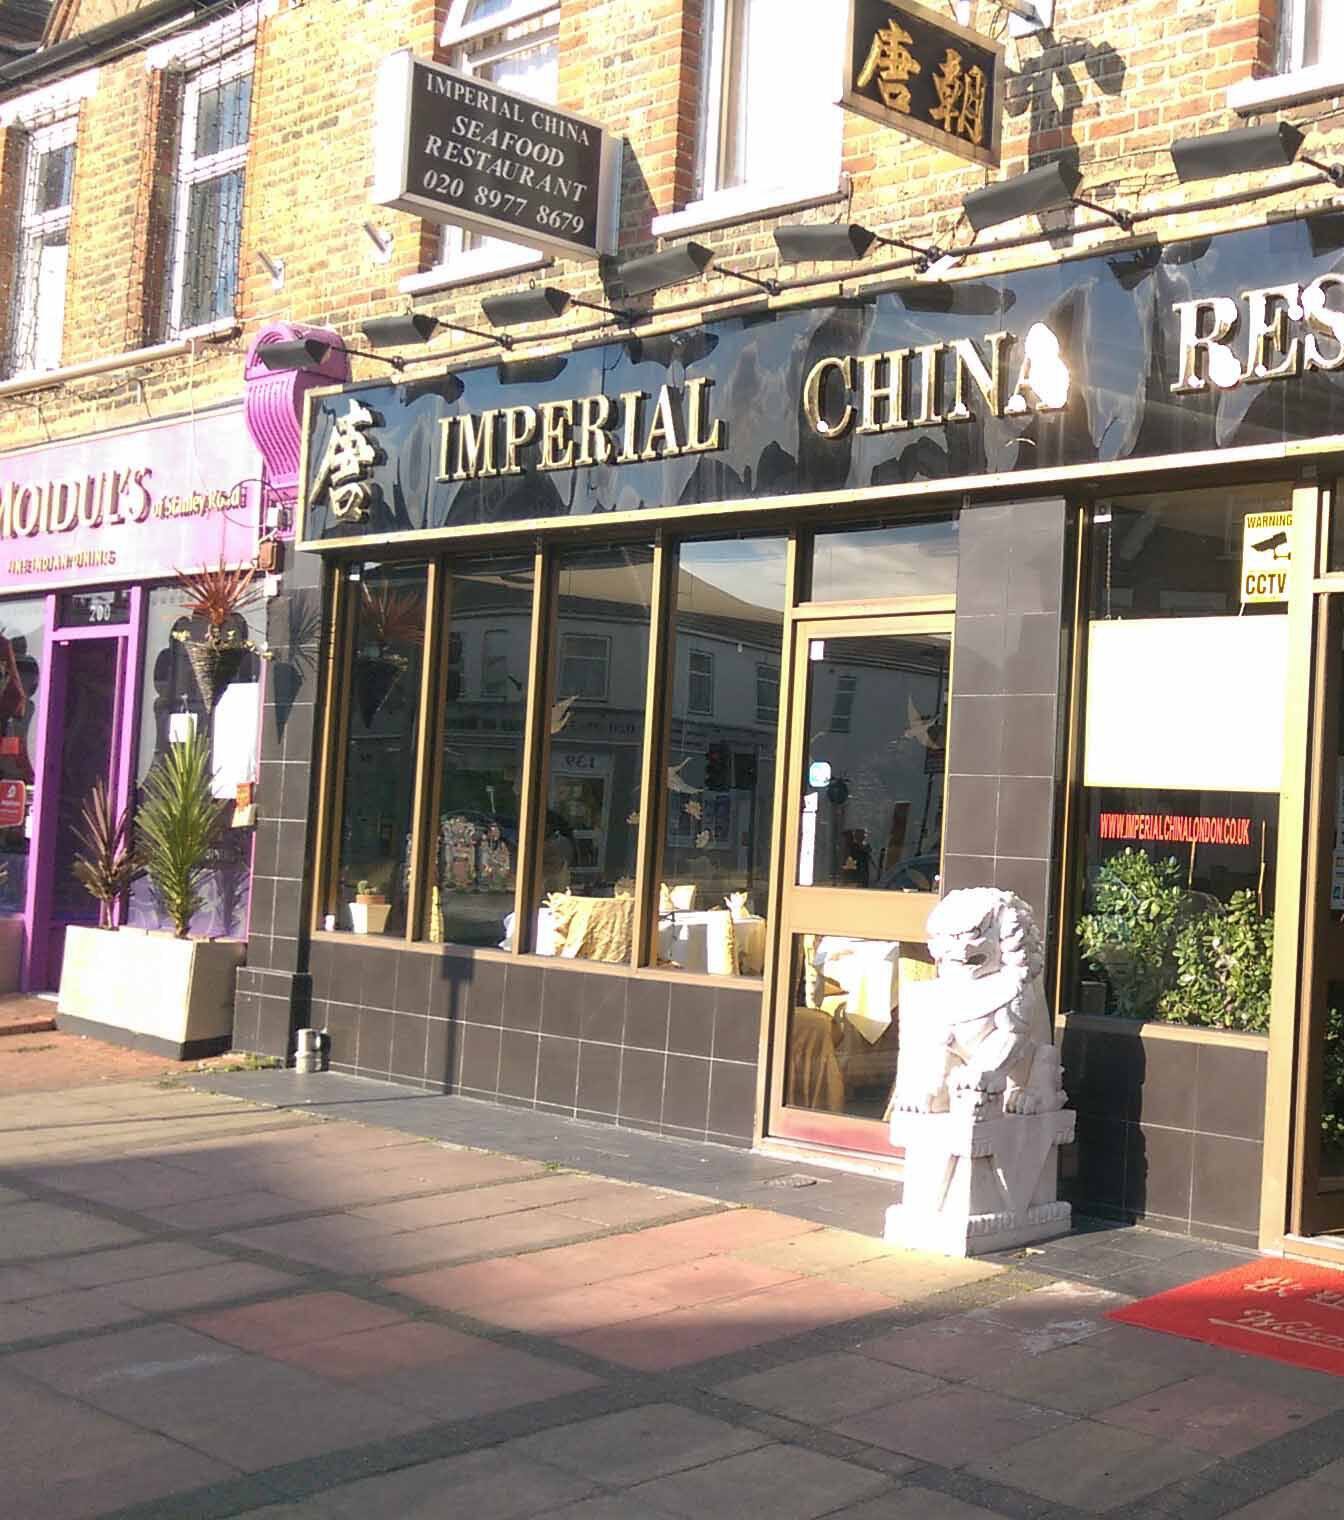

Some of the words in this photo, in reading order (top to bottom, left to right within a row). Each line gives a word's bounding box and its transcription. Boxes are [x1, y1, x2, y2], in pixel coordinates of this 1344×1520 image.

[427, 72, 525, 123] IMPERIAL
[531, 111, 590, 147] CHINA
[857, 18, 986, 144] 唐朝
[424, 135, 588, 203] RESTAURANT
[451, 115, 565, 168] SEAFOOD
[423, 169, 464, 198] 020
[474, 185, 528, 217] 8977
[536, 204, 585, 235] 8679
[435, 378, 728, 484] IMPERIAL
[803, 324, 1069, 439] CHINA
[309, 398, 375, 520] 唐
[1247, 514, 1293, 529] WARNING
[89, 604, 111, 622] 200
[1246, 573, 1287, 595] CCTV
[1100, 812, 1251, 846] WWW.IMPERIALCHINALONDON.CO.UK
